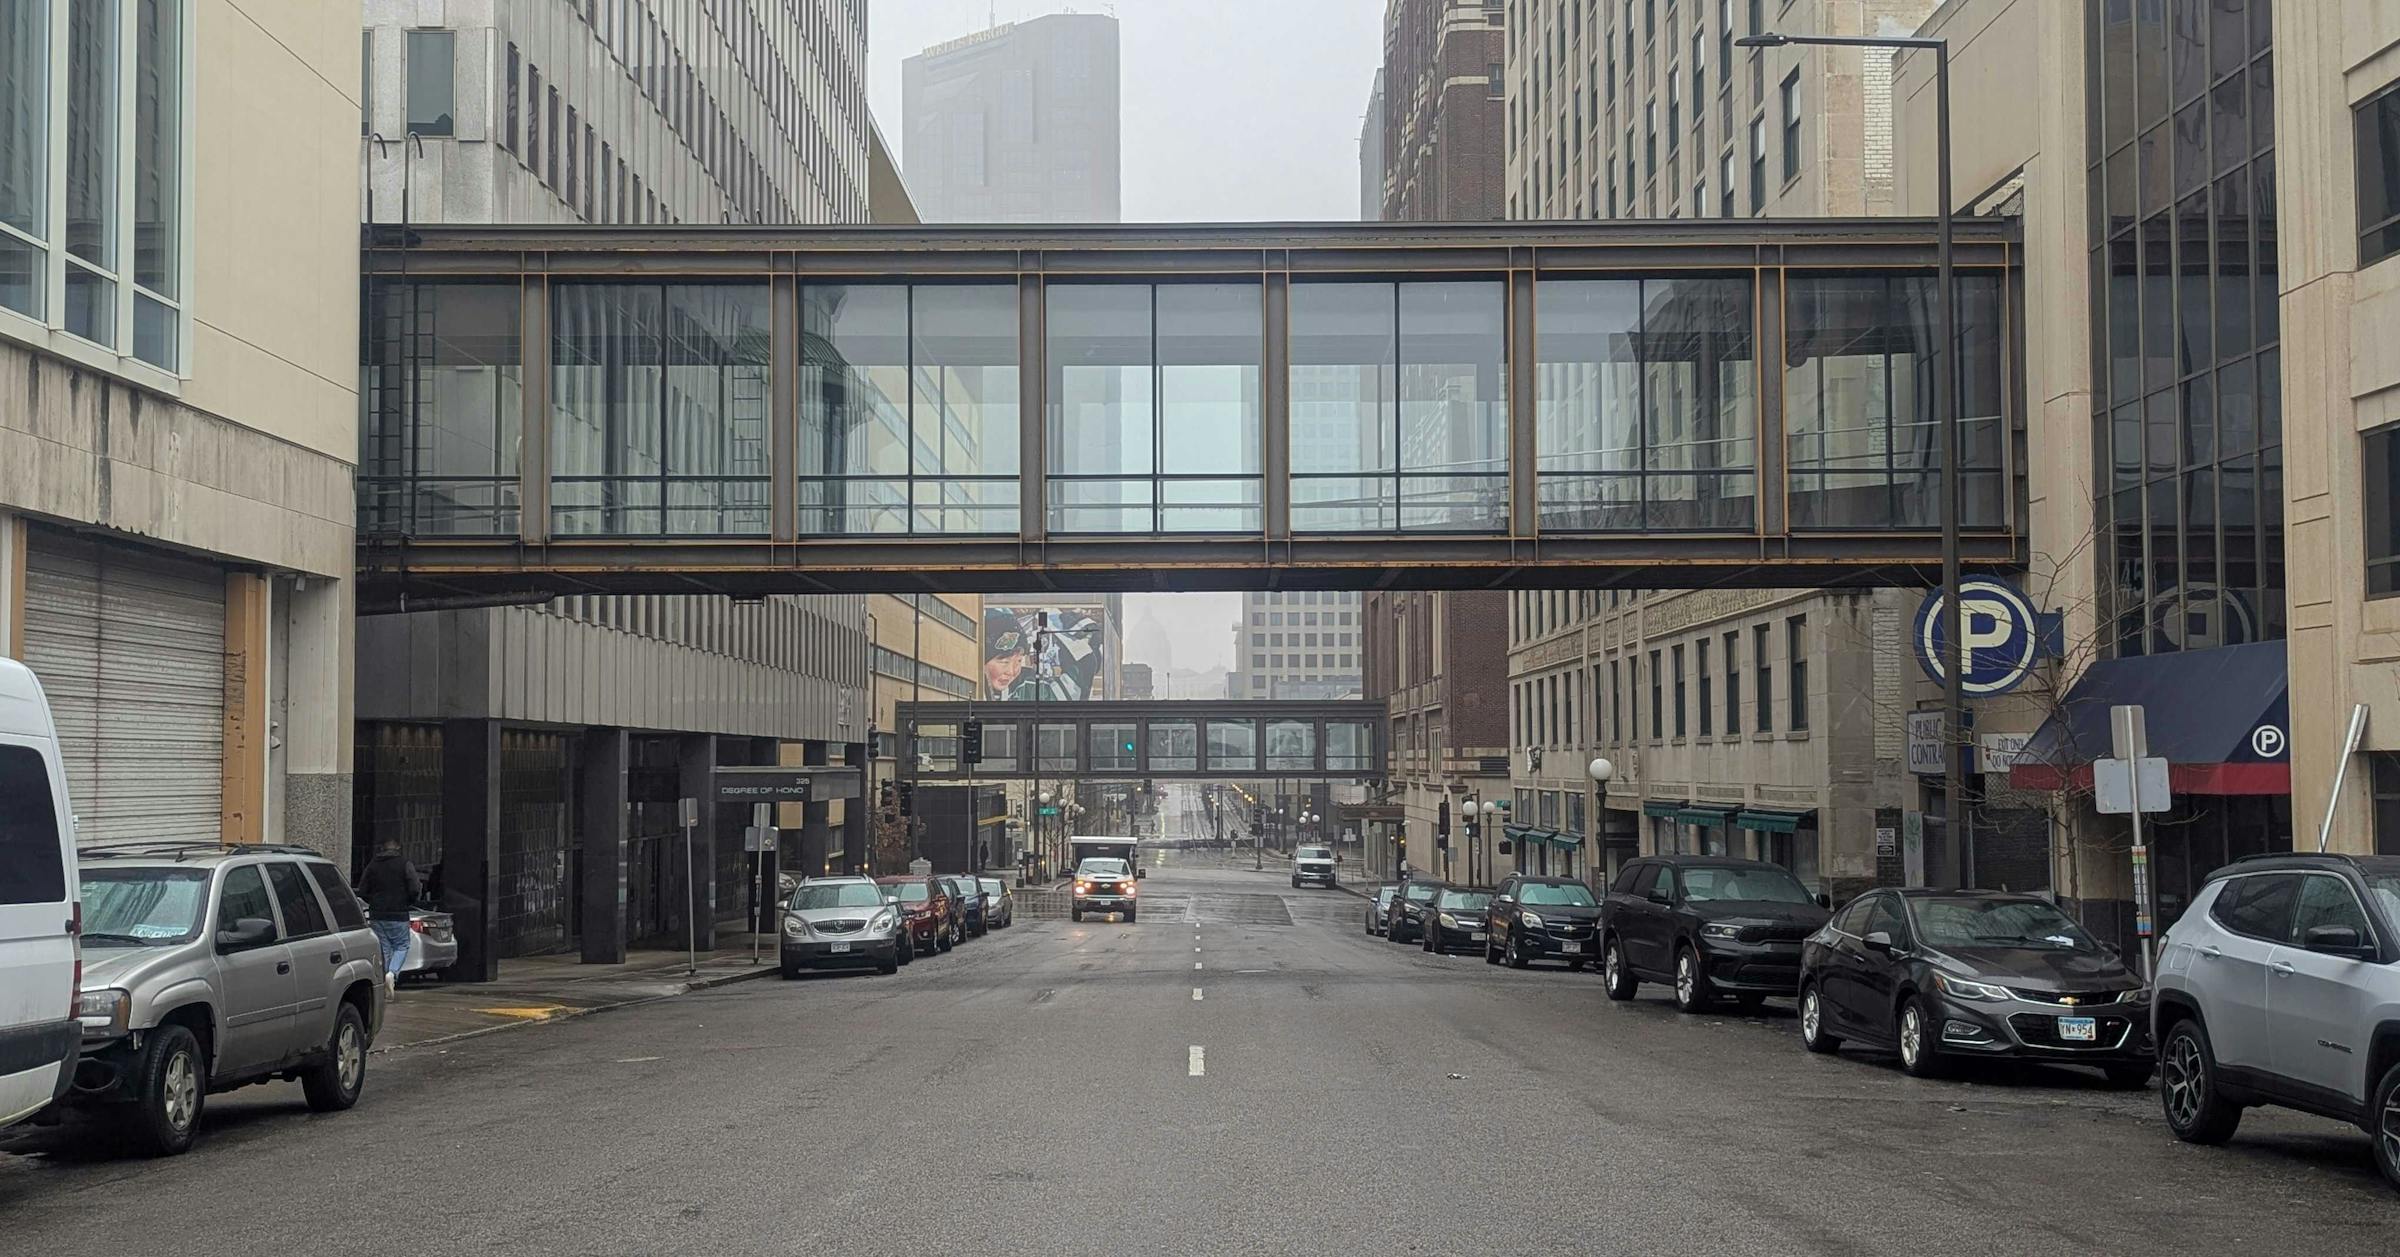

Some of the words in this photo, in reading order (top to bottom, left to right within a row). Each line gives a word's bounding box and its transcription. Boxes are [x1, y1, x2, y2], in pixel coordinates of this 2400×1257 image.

[926, 37, 967, 57] WELLS
[969, 25, 1009, 45] FARGO
[1959, 599, 2012, 675] P
[1915, 718, 1942, 740] PUBLIC
[2261, 730, 2278, 751] P
